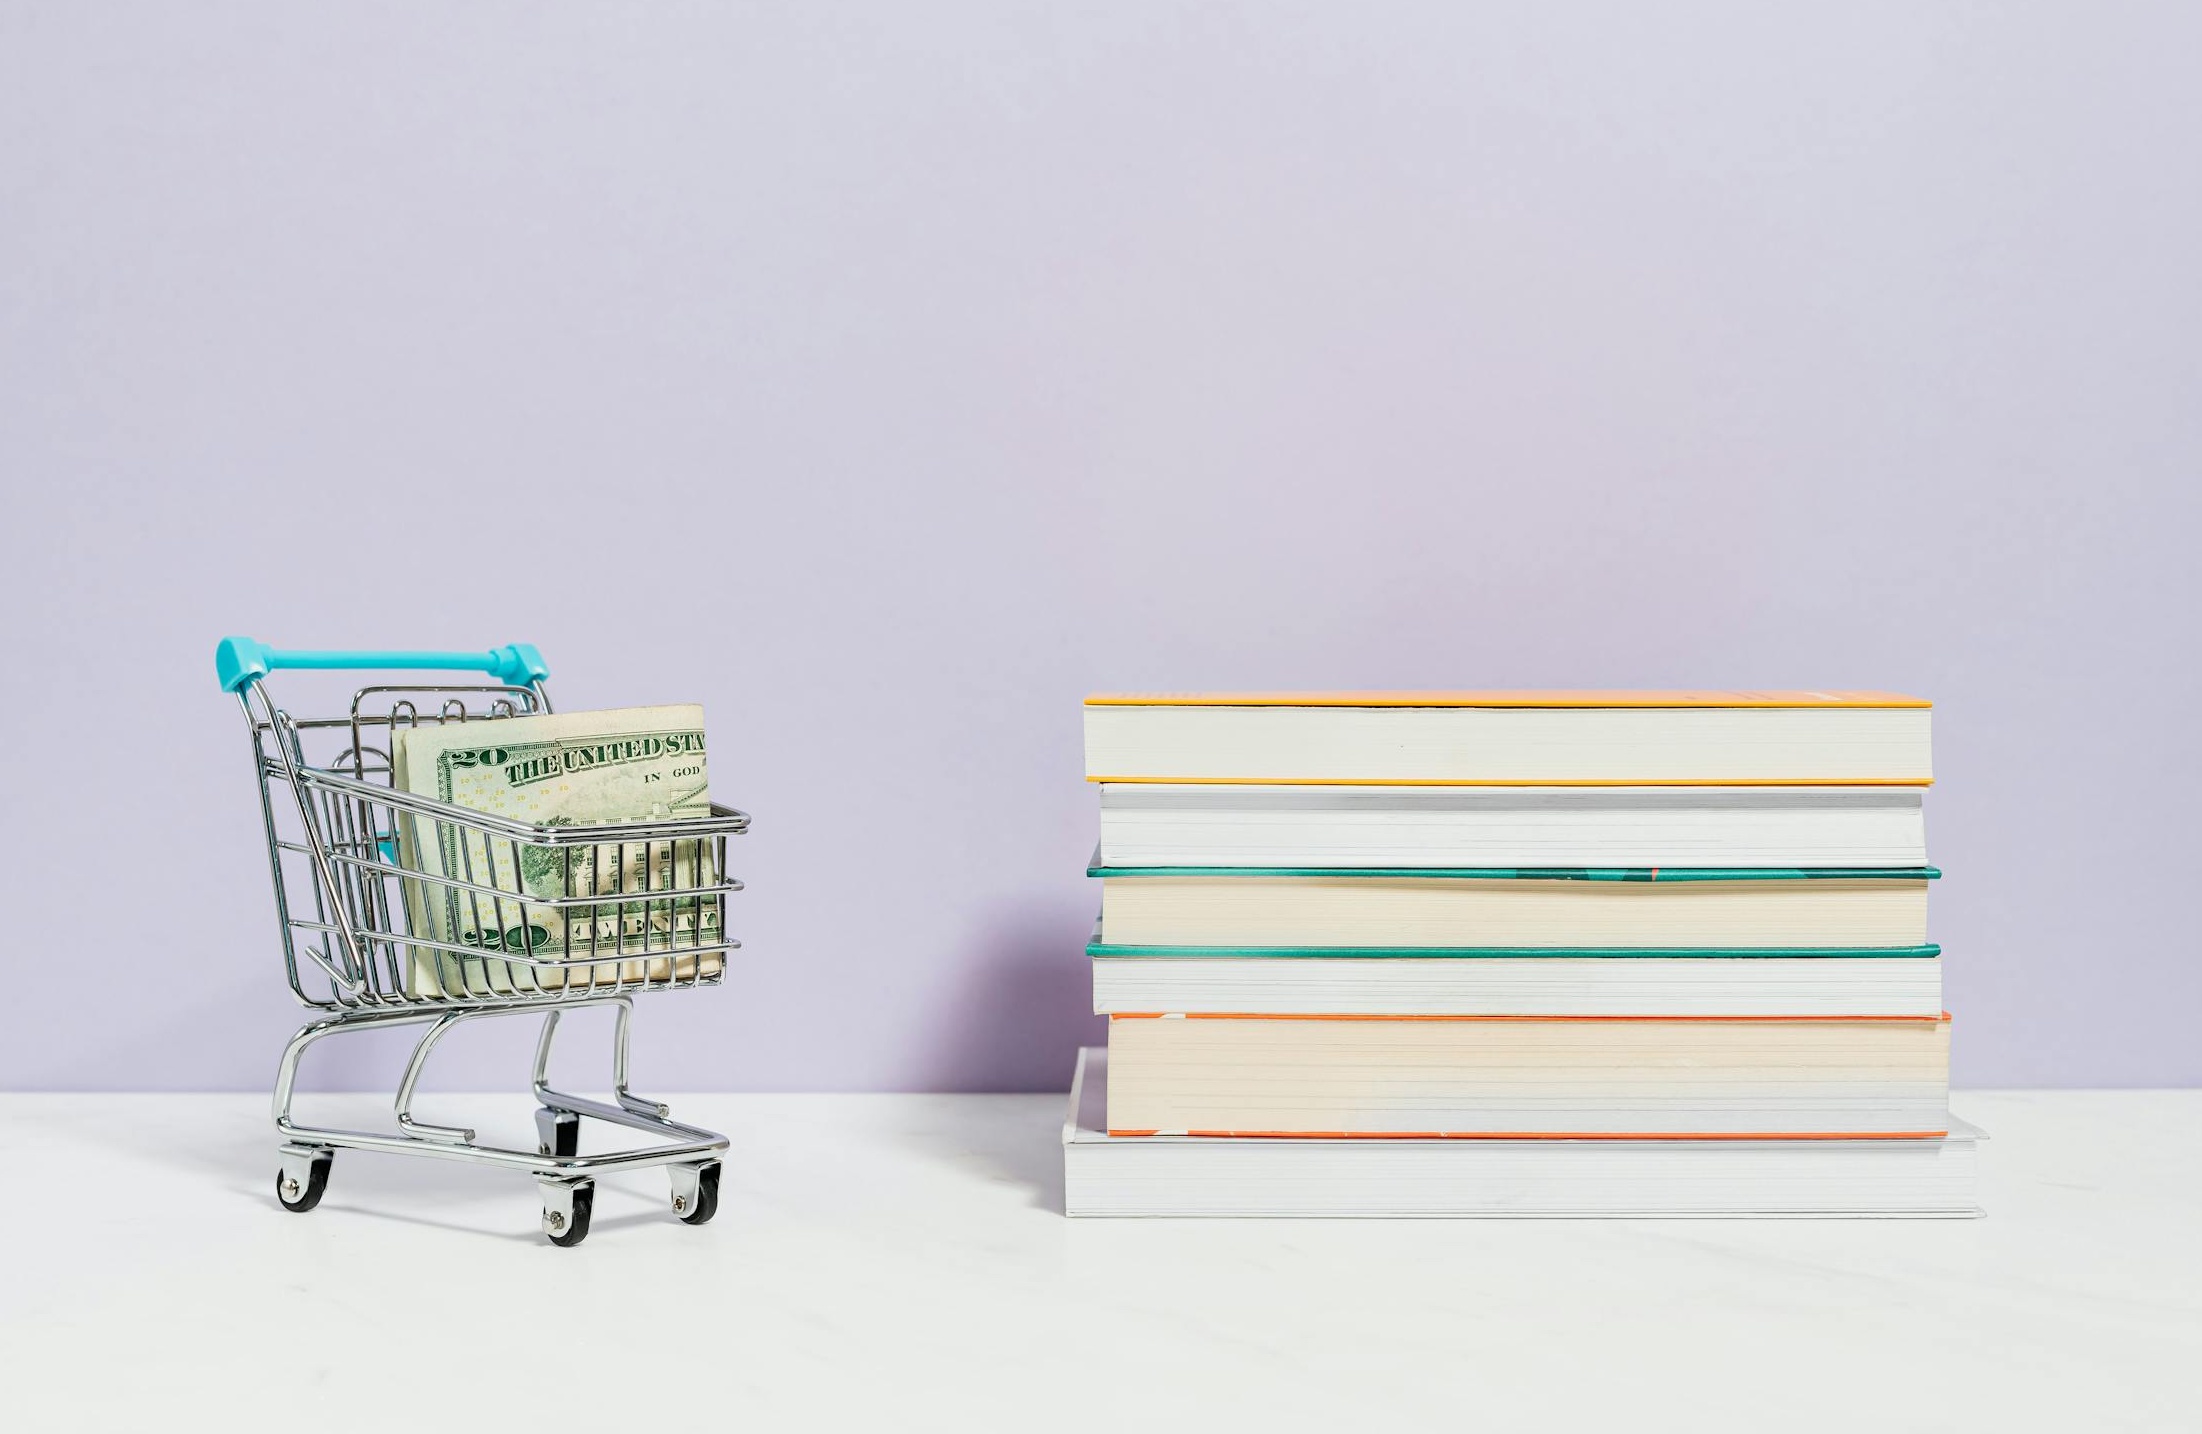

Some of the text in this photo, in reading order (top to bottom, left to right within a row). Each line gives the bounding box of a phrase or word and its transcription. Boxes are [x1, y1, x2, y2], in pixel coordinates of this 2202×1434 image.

[450, 748, 510, 770] 20
[505, 756, 563, 787] THE
[562, 737, 664, 773] UNITED
[644, 766, 700, 784] IN GOD
